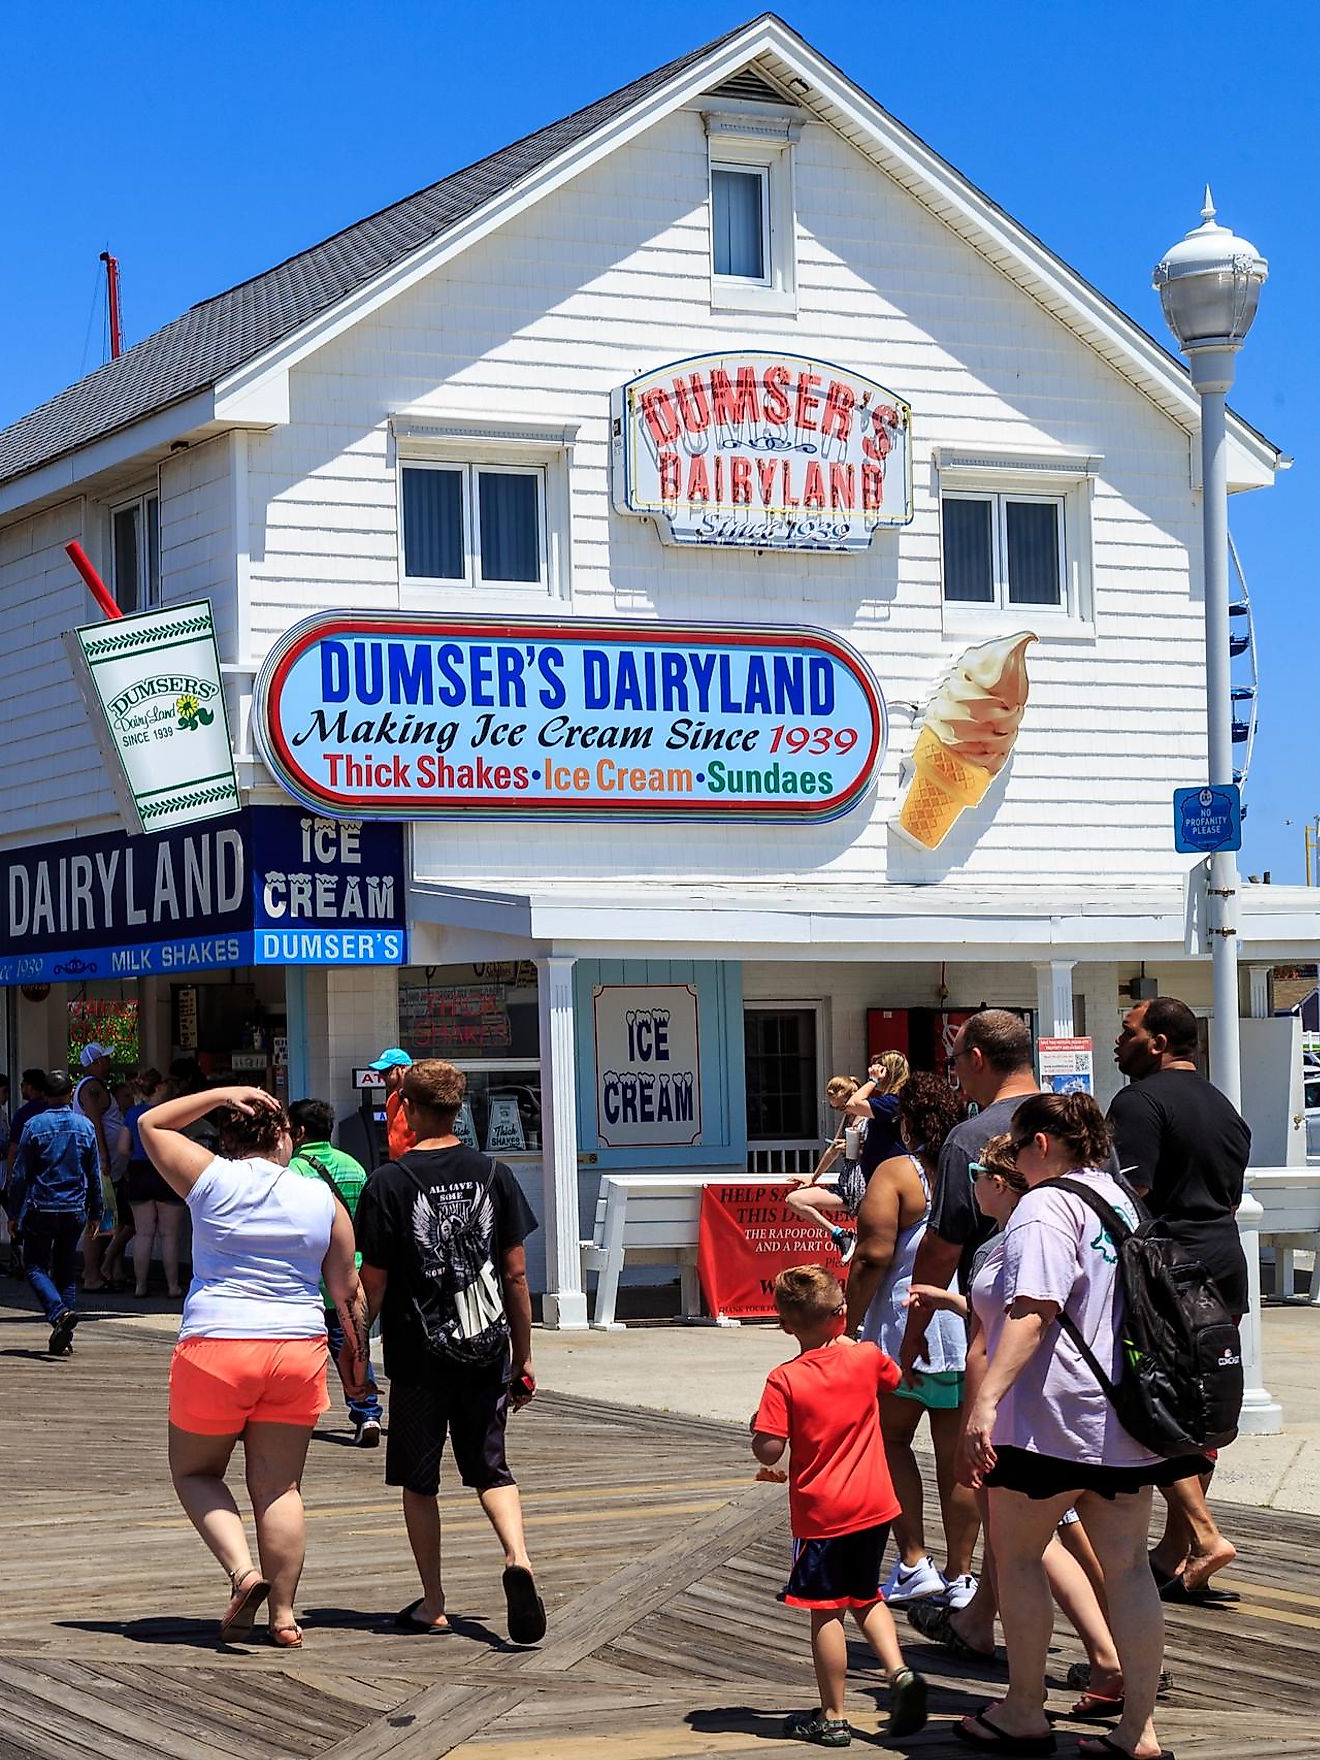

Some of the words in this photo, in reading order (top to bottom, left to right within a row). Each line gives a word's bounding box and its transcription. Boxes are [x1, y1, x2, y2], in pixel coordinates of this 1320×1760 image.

[638, 365, 899, 461] DUMSER'S
[659, 451, 885, 510] DAIRYLAND
[699, 511, 778, 539] Since
[320, 640, 566, 710] DUMSER'S
[583, 649, 835, 716] DAIRYLAND
[122, 731, 150, 748] SINCE
[153, 726, 174, 740] 1939
[292, 709, 460, 754] Making
[471, 713, 527, 748] Ice
[538, 715, 653, 749] Cream
[666, 718, 760, 752] Since
[769, 725, 858, 756] 1939
[323, 754, 411, 788] Thick
[416, 755, 529, 790] Shakes
[544, 757, 590, 790] Ice
[597, 758, 693, 792] Cream
[708, 760, 834, 795] Sundaes
[1185, 816, 1227, 827] PROFANITY
[1200, 808, 1212, 817] NO
[300, 817, 363, 864] ICE
[1192, 825, 1221, 835] PLEASE
[9, 828, 244, 937] DAIRYLAND
[263, 870, 395, 919] CREAM
[112, 947, 153, 973] MILK
[161, 938, 240, 967] SHAKES
[263, 933, 399, 959] DUMSER'S
[16, 957, 43, 978] 1939
[424, 992, 498, 1016] THICK
[414, 1019, 510, 1045] SHAKES
[625, 1008, 670, 1062] ICE
[361, 1073, 385, 1084] AT
[603, 1070, 694, 1125] CREAM
[491, 1137, 521, 1147] SHAKES
[493, 1123, 518, 1138] Thick
[430, 1185, 447, 1194] ALL
[721, 1187, 766, 1203] HELP
[737, 1207, 777, 1223] THIS
[745, 1229, 767, 1240] THE
[755, 1242, 780, 1252] AND
[782, 1242, 791, 1252] A
[793, 1241, 823, 1252] PART
